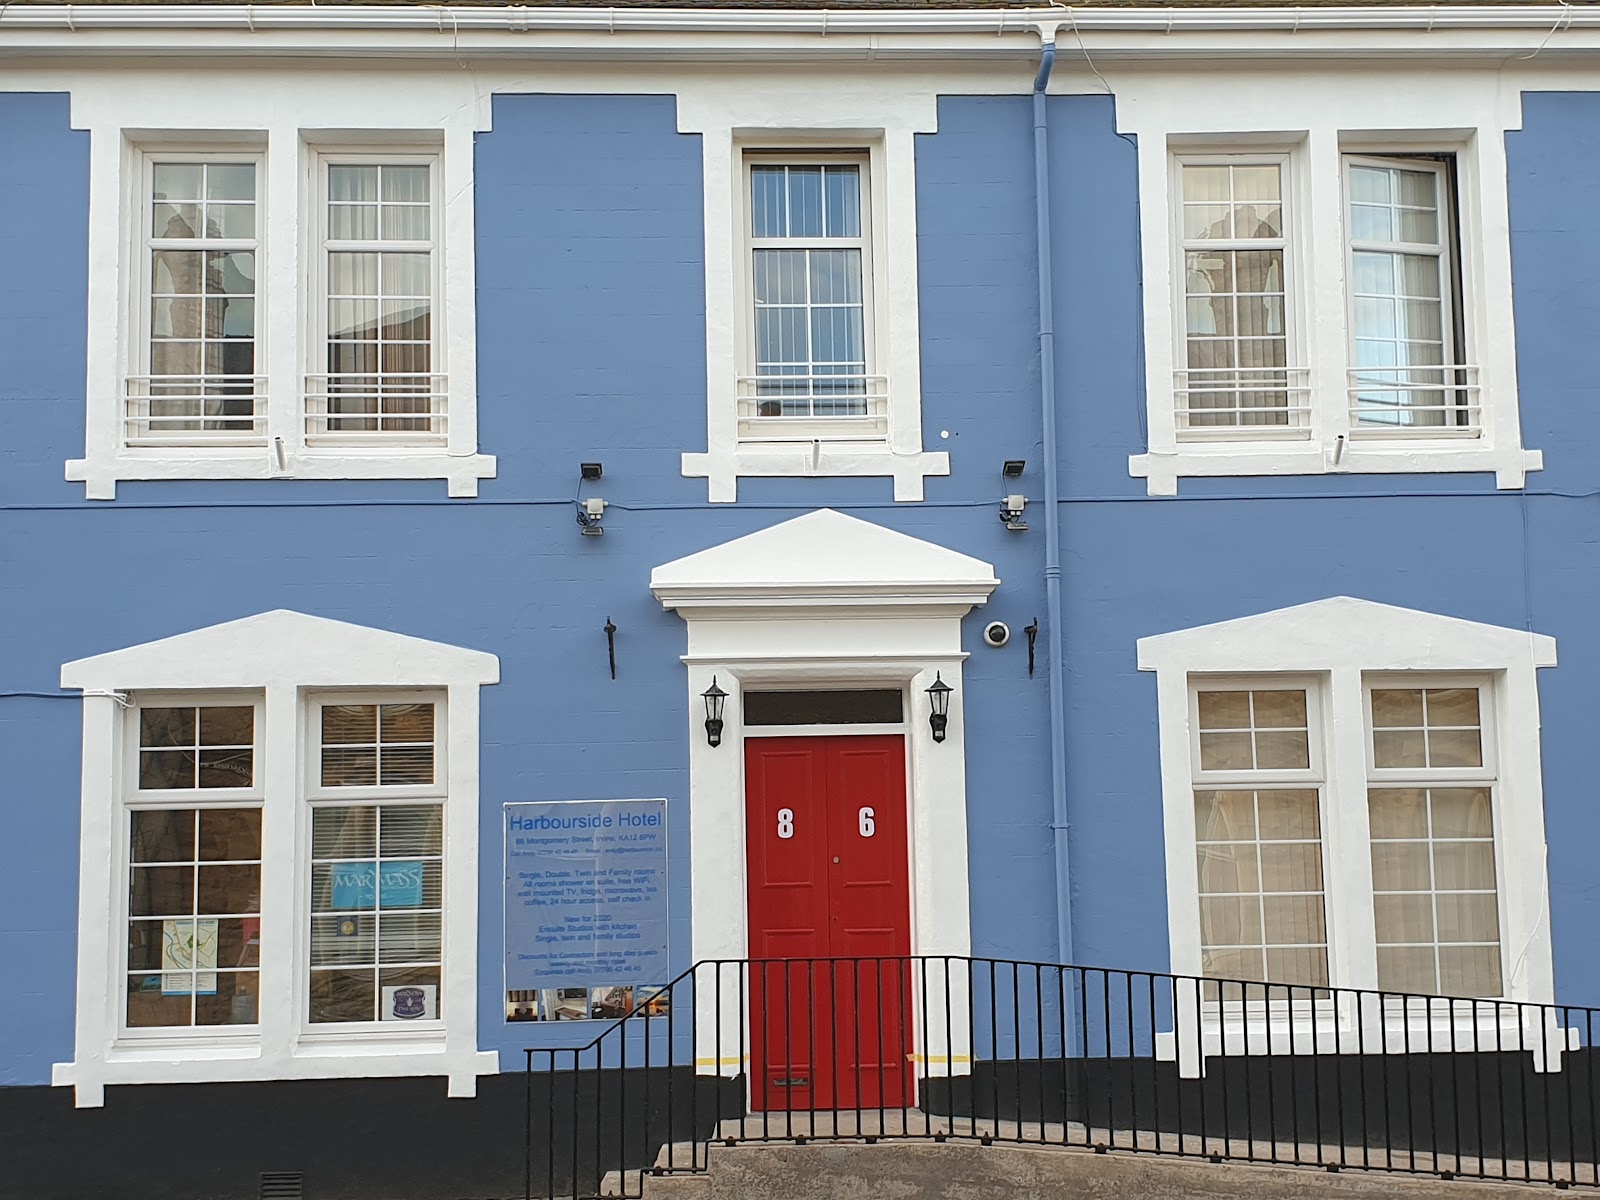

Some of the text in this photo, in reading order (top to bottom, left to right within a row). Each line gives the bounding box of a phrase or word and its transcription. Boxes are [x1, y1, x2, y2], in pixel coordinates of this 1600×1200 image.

[510, 811, 662, 831] Harbourside Hotel
[777, 806, 876, 839] 8 6
[526, 837, 570, 845] Montgomery
[618, 833, 638, 841] KA12
[334, 869, 420, 889] MARMASS
[519, 871, 543, 879] Single,
[545, 870, 572, 878] Double,
[575, 869, 592, 877] Twin
[608, 868, 632, 876] Family
[617, 877, 631, 885] free
[607, 895, 621, 903] self
[621, 895, 643, 903] check
[593, 914, 612, 922] 2020
[592, 932, 614, 940] family
